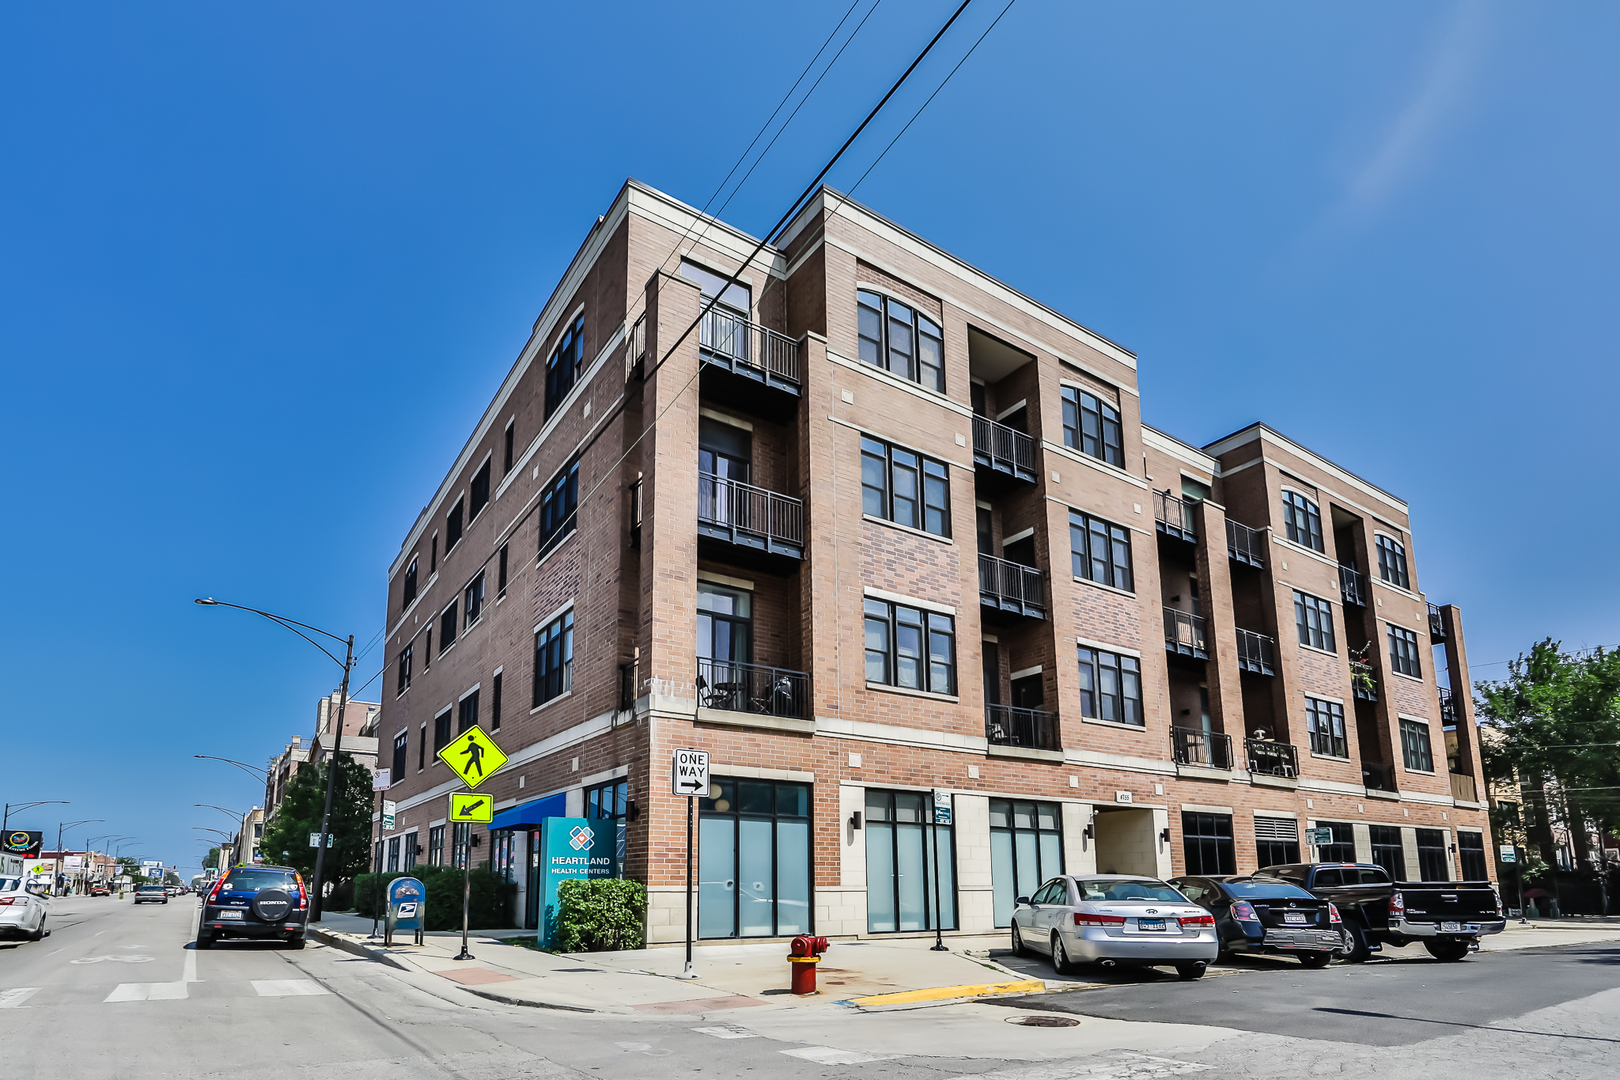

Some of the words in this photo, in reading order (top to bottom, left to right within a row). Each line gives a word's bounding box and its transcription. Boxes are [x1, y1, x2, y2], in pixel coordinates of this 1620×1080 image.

[680, 753, 705, 765] ONE
[679, 765, 705, 778] WAY
[551, 856, 610, 865] HEARTLAND
